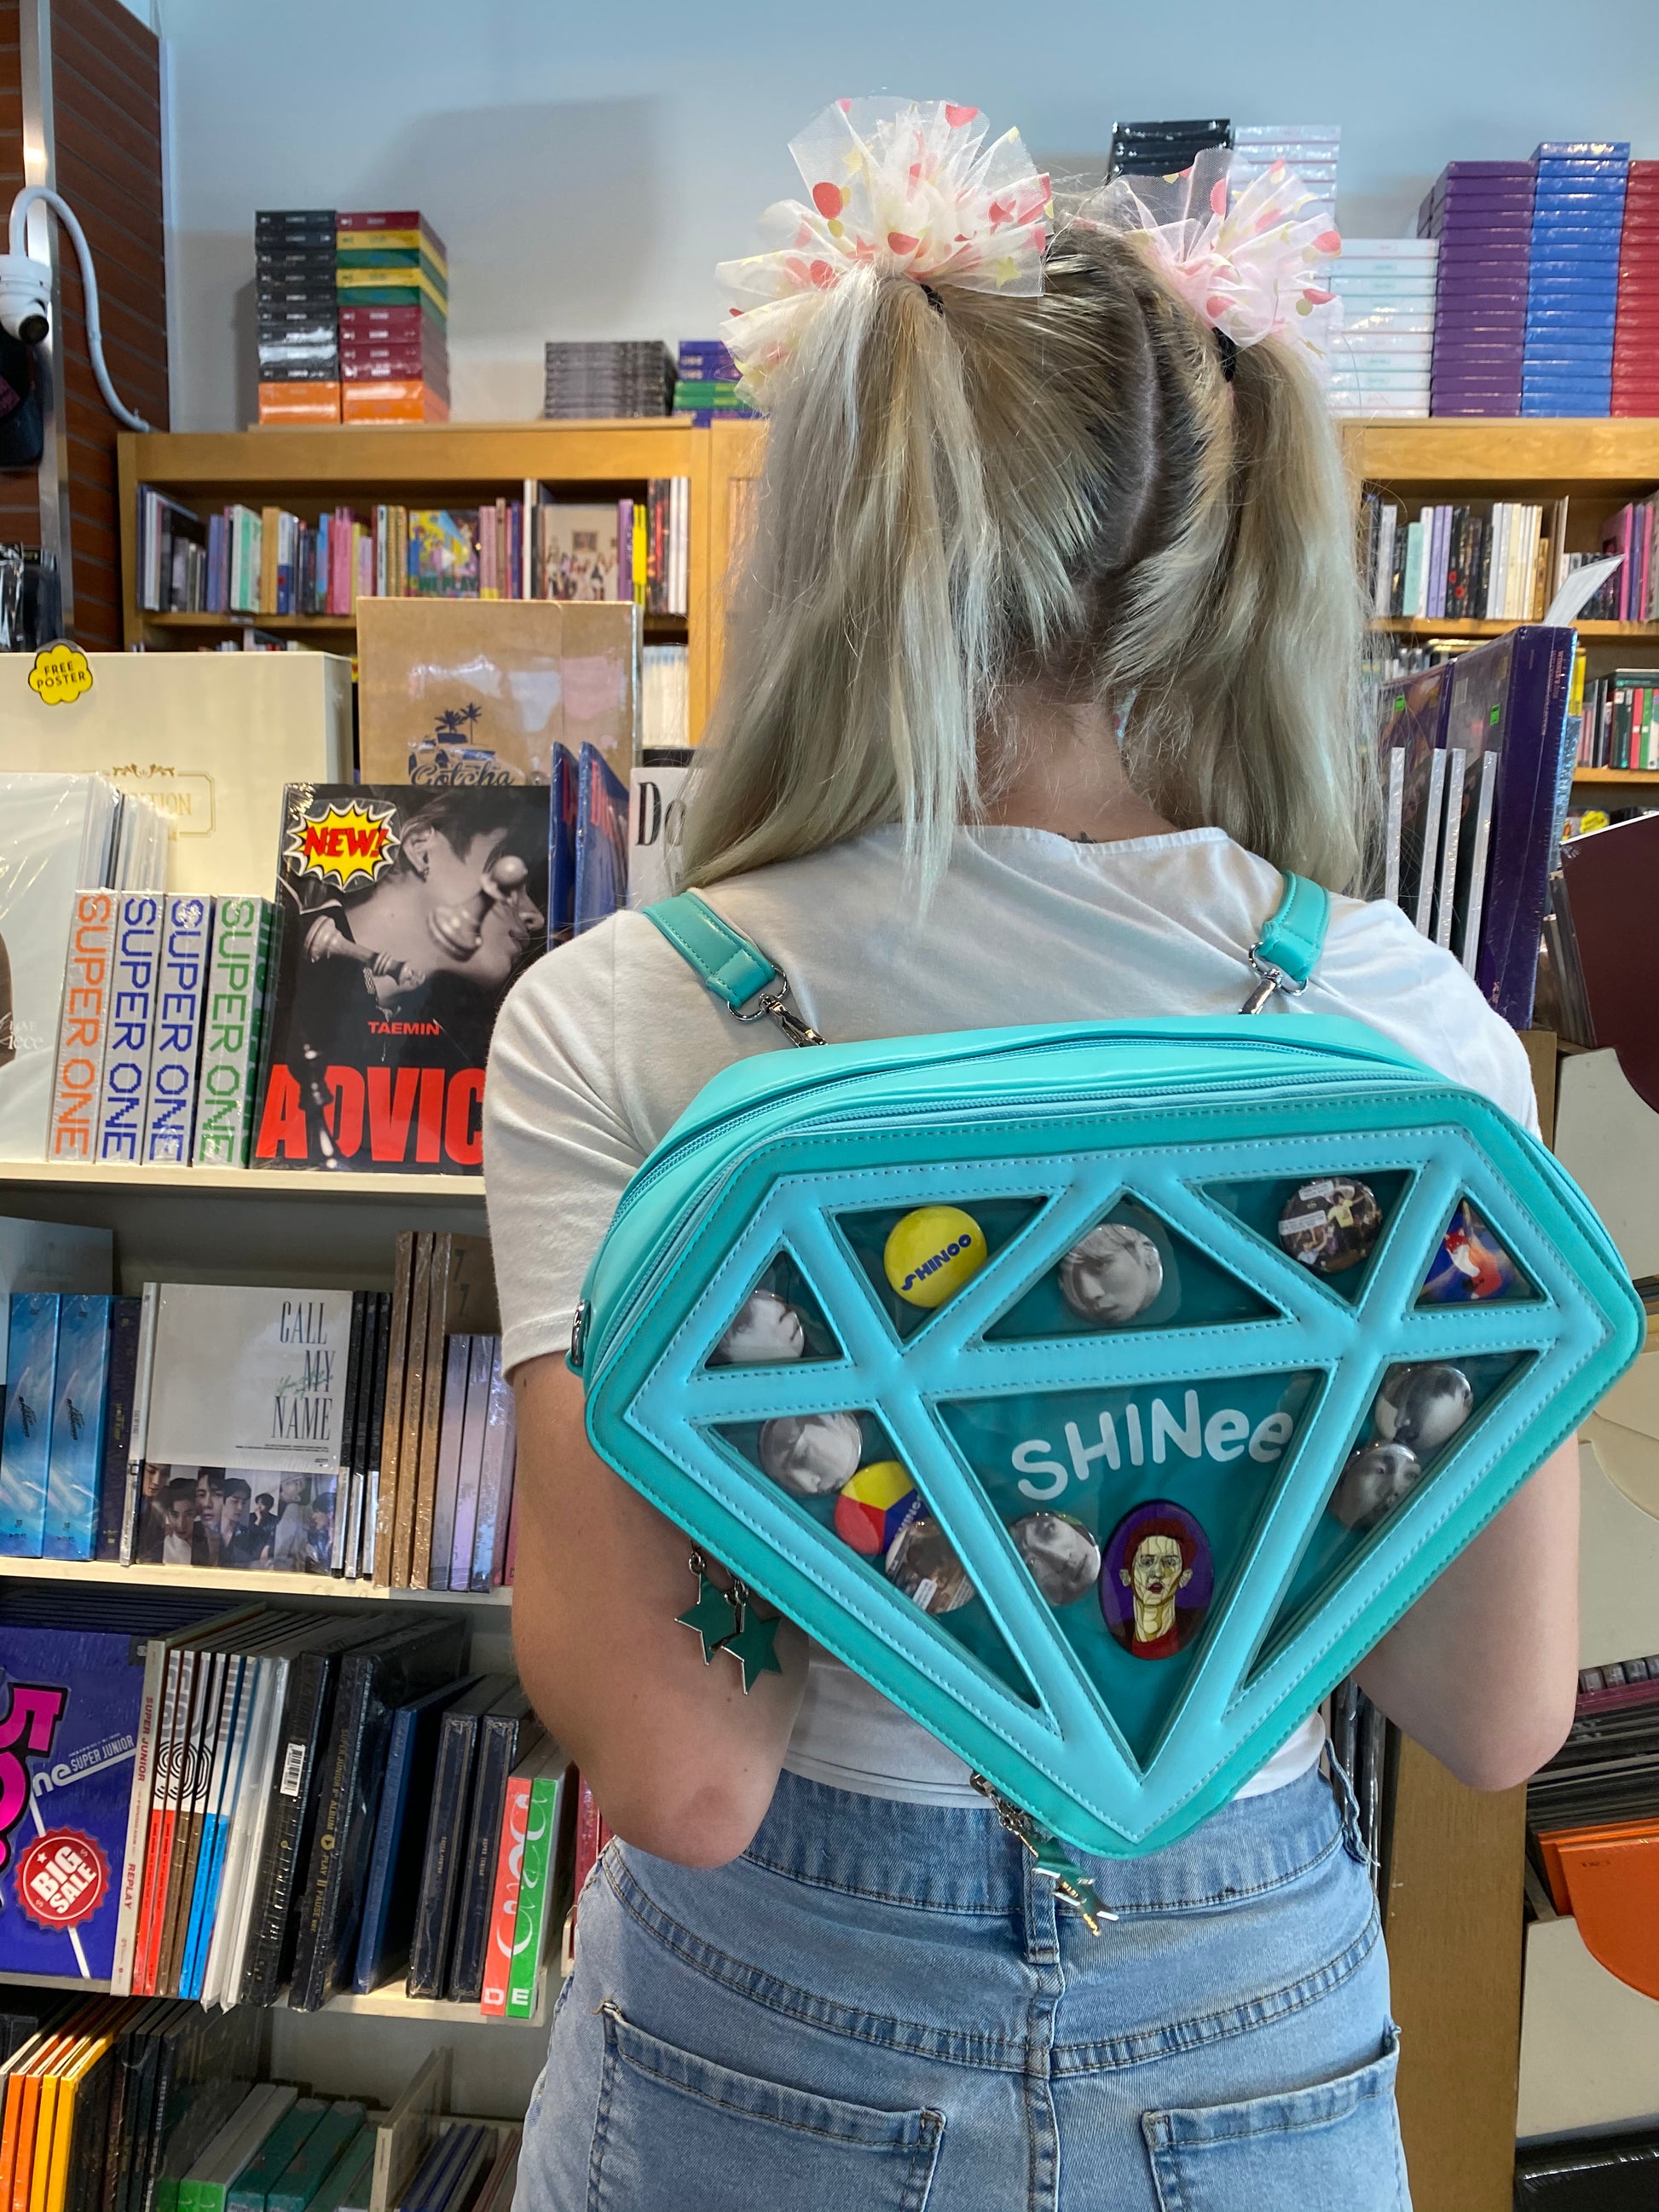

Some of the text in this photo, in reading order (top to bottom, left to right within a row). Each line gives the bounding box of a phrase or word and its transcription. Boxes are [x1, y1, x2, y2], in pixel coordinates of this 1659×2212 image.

[37, 671, 85, 689] POSTER
[44, 661, 74, 675] FREE
[303, 826, 390, 858] NEW!
[55, 893, 112, 1156] SUPER ONE
[101, 898, 157, 1160] SUPER ONE
[148, 899, 205, 1162] SUPER ONE
[199, 899, 255, 1163] SUPER ONE
[367, 1021, 440, 1036] TAEMIN
[255, 1064, 486, 1165] ADVIC
[280, 1301, 327, 1345] CALL
[303, 1349, 336, 1393] MY
[271, 1395, 332, 1441] NAME
[1011, 1389, 1293, 1500] SHINee
[142, 1695, 153, 1734] SUPER
[71, 1750, 102, 1772] SUPER
[103, 1734, 135, 1759] JUNIOR
[137, 1737, 149, 1782] JUNIOR
[332, 1756, 345, 1788] JUNIOR
[327, 1799, 338, 1830] ALBUM
[30, 1845, 83, 1902] BIG
[124, 1863, 136, 1909] REPLAY
[320, 1854, 330, 1875] PLAY
[49, 1863, 97, 1915] SALE
[312, 1890, 324, 1917] PAUSE
